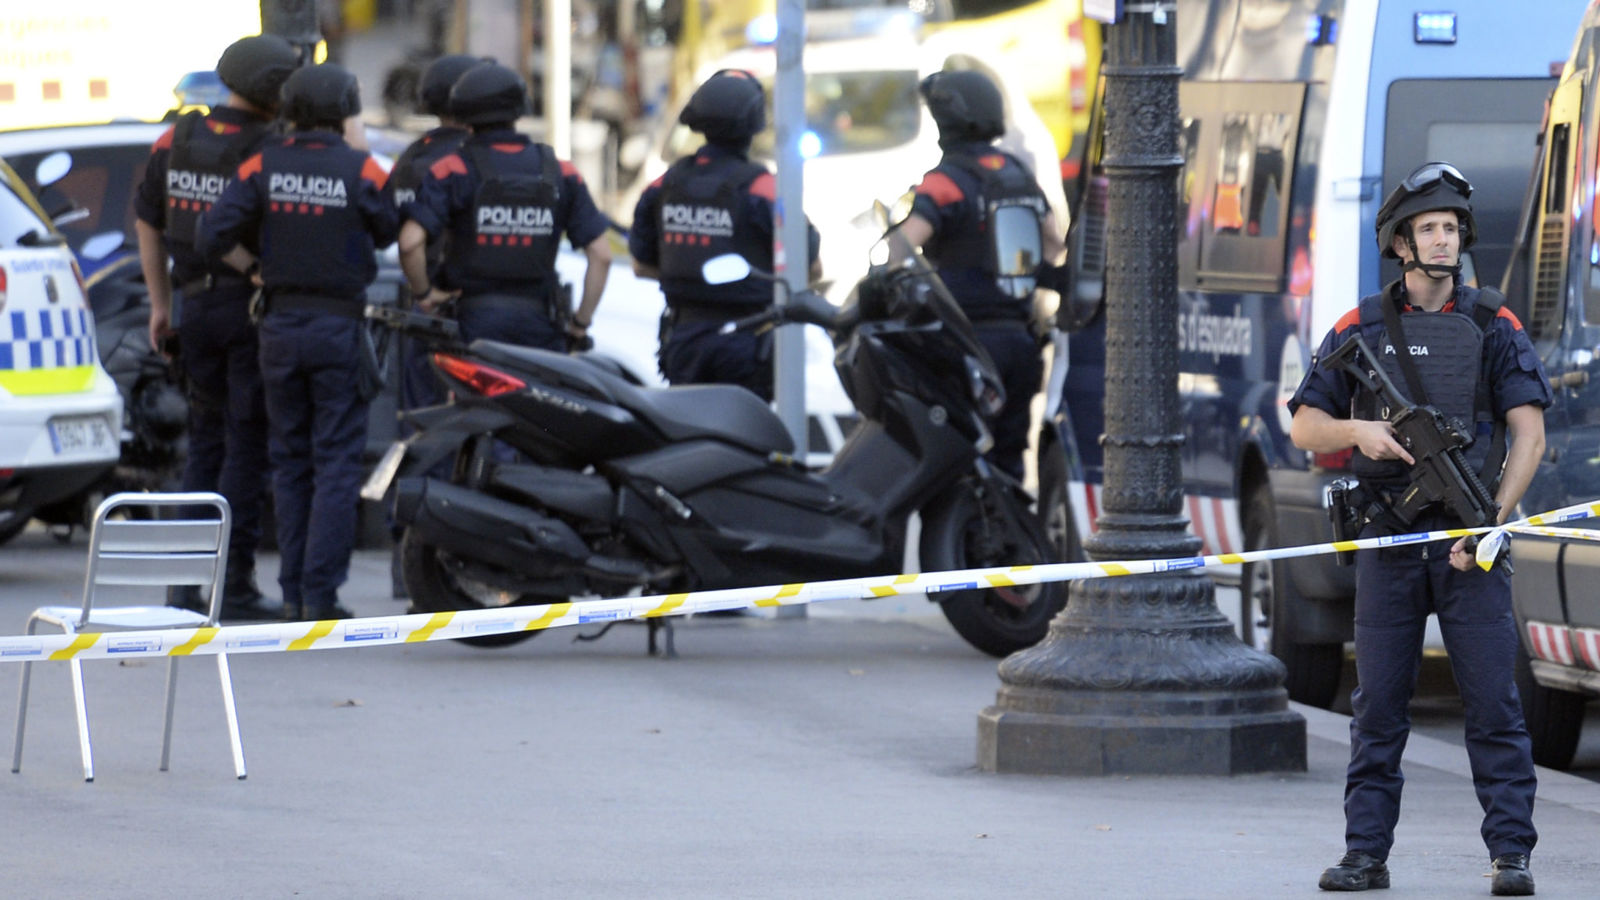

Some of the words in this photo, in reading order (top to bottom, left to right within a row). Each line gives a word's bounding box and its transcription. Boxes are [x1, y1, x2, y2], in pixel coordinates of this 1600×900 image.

[167, 169, 231, 194] POLICI
[269, 173, 347, 198] POLICIA
[478, 206, 554, 226] POLICIA
[662, 203, 733, 228] POLICIA
[1385, 345, 1429, 356] PCIA
